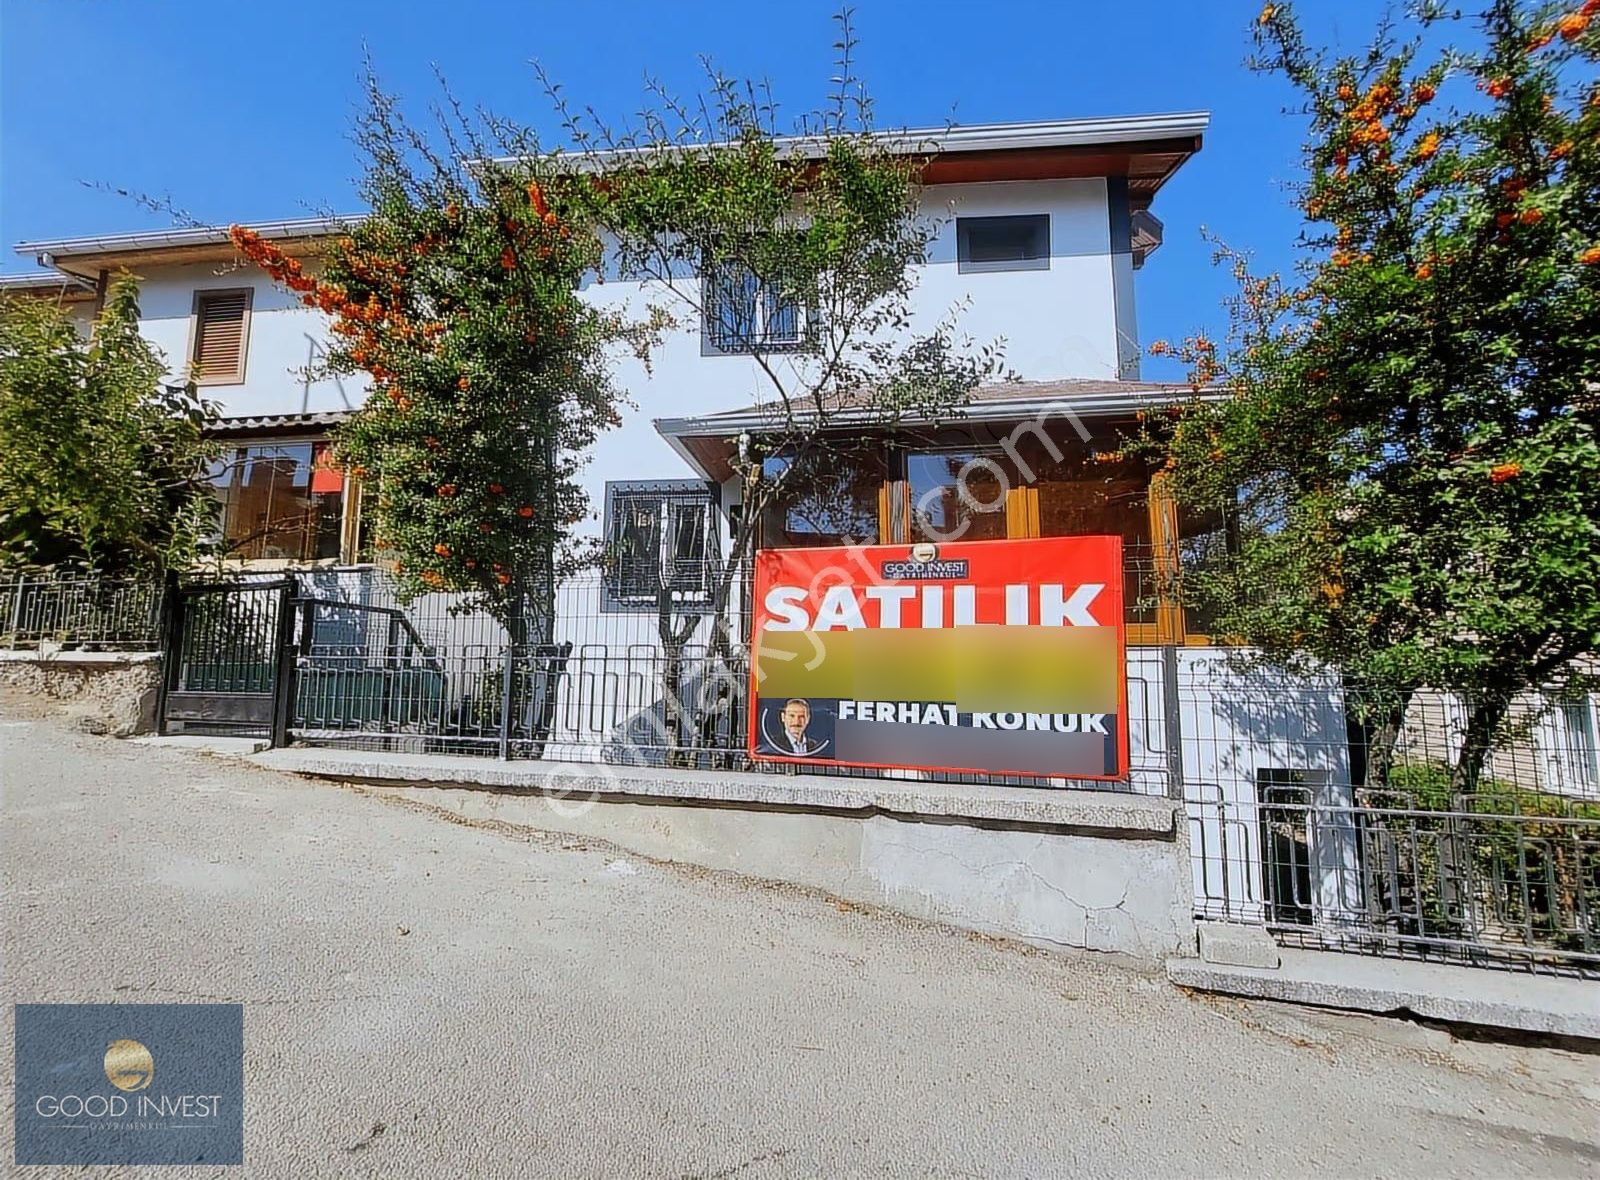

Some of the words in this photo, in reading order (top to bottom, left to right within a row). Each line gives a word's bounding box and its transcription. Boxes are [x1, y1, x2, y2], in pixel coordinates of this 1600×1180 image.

[884, 563, 925, 573] GOOD
[927, 561, 964, 573] INVEST
[764, 583, 1105, 632] SATILIK
[838, 700, 958, 727] FERHAT
[972, 712, 1110, 736] KONUK
